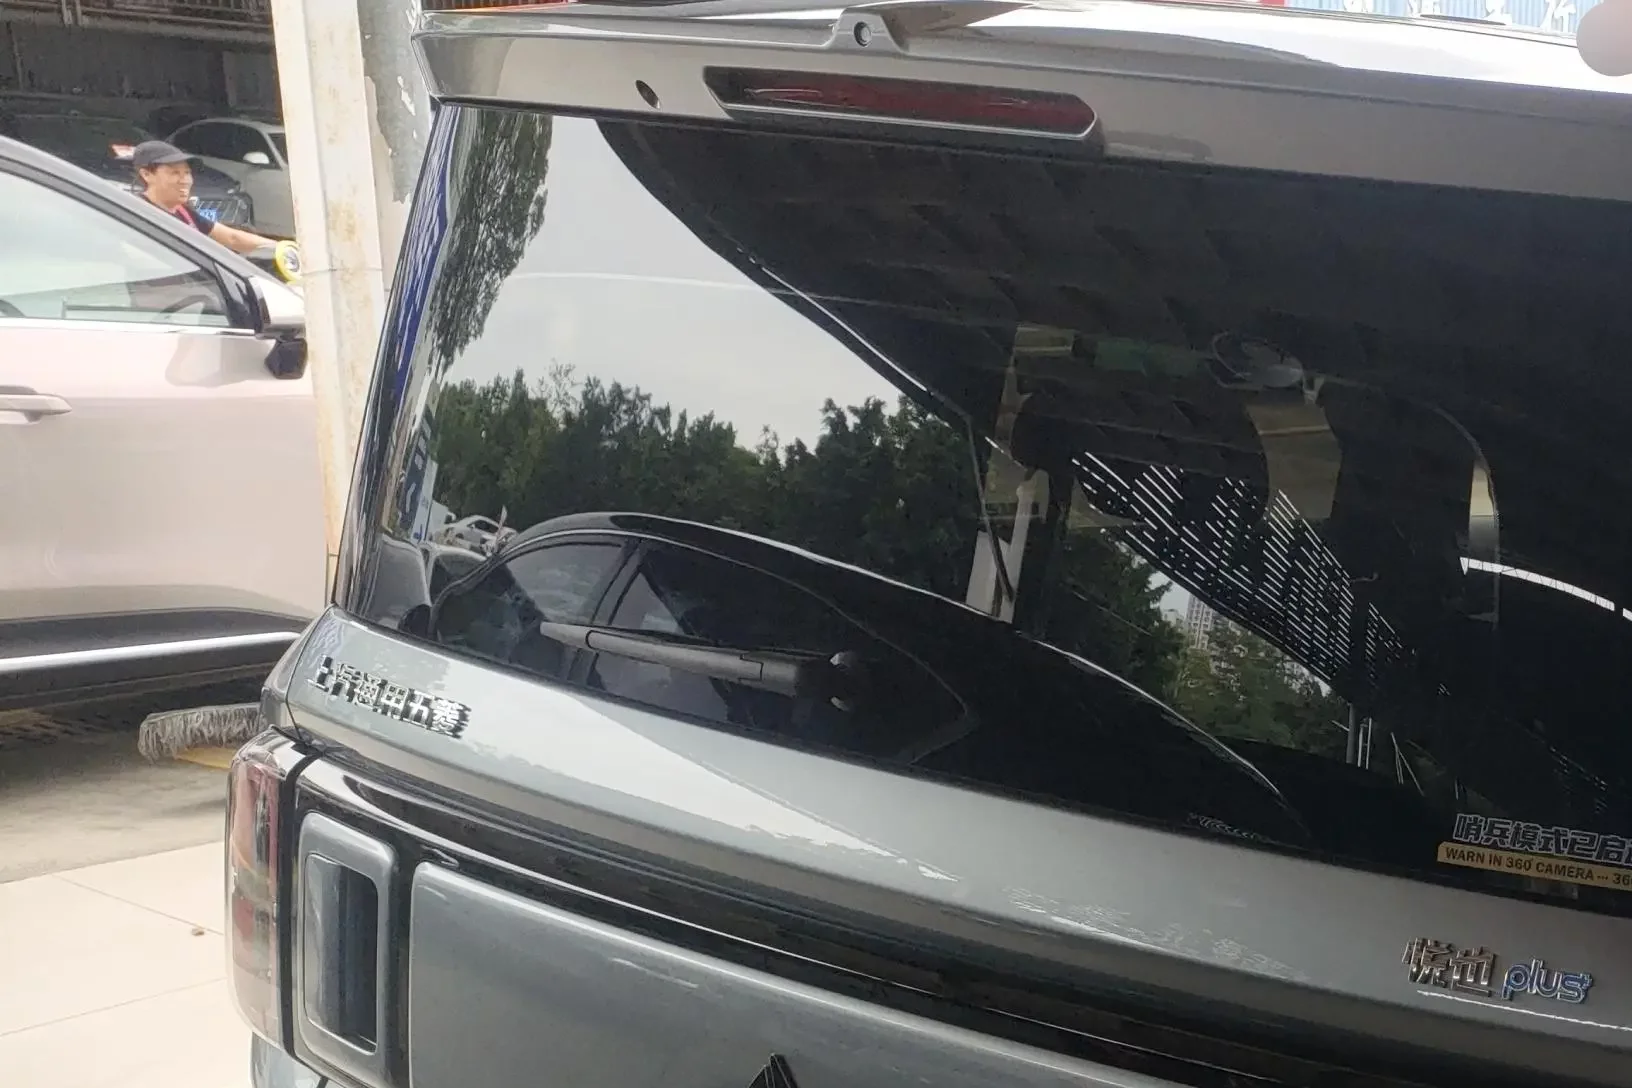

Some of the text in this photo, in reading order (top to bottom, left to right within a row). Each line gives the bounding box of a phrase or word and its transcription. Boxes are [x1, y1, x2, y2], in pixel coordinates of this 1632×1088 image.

[1445, 848, 1485, 864] WARN
[1488, 853, 1502, 866] IN
[1535, 862, 1594, 881] CAMERA
[1501, 959, 1593, 1004] plus
